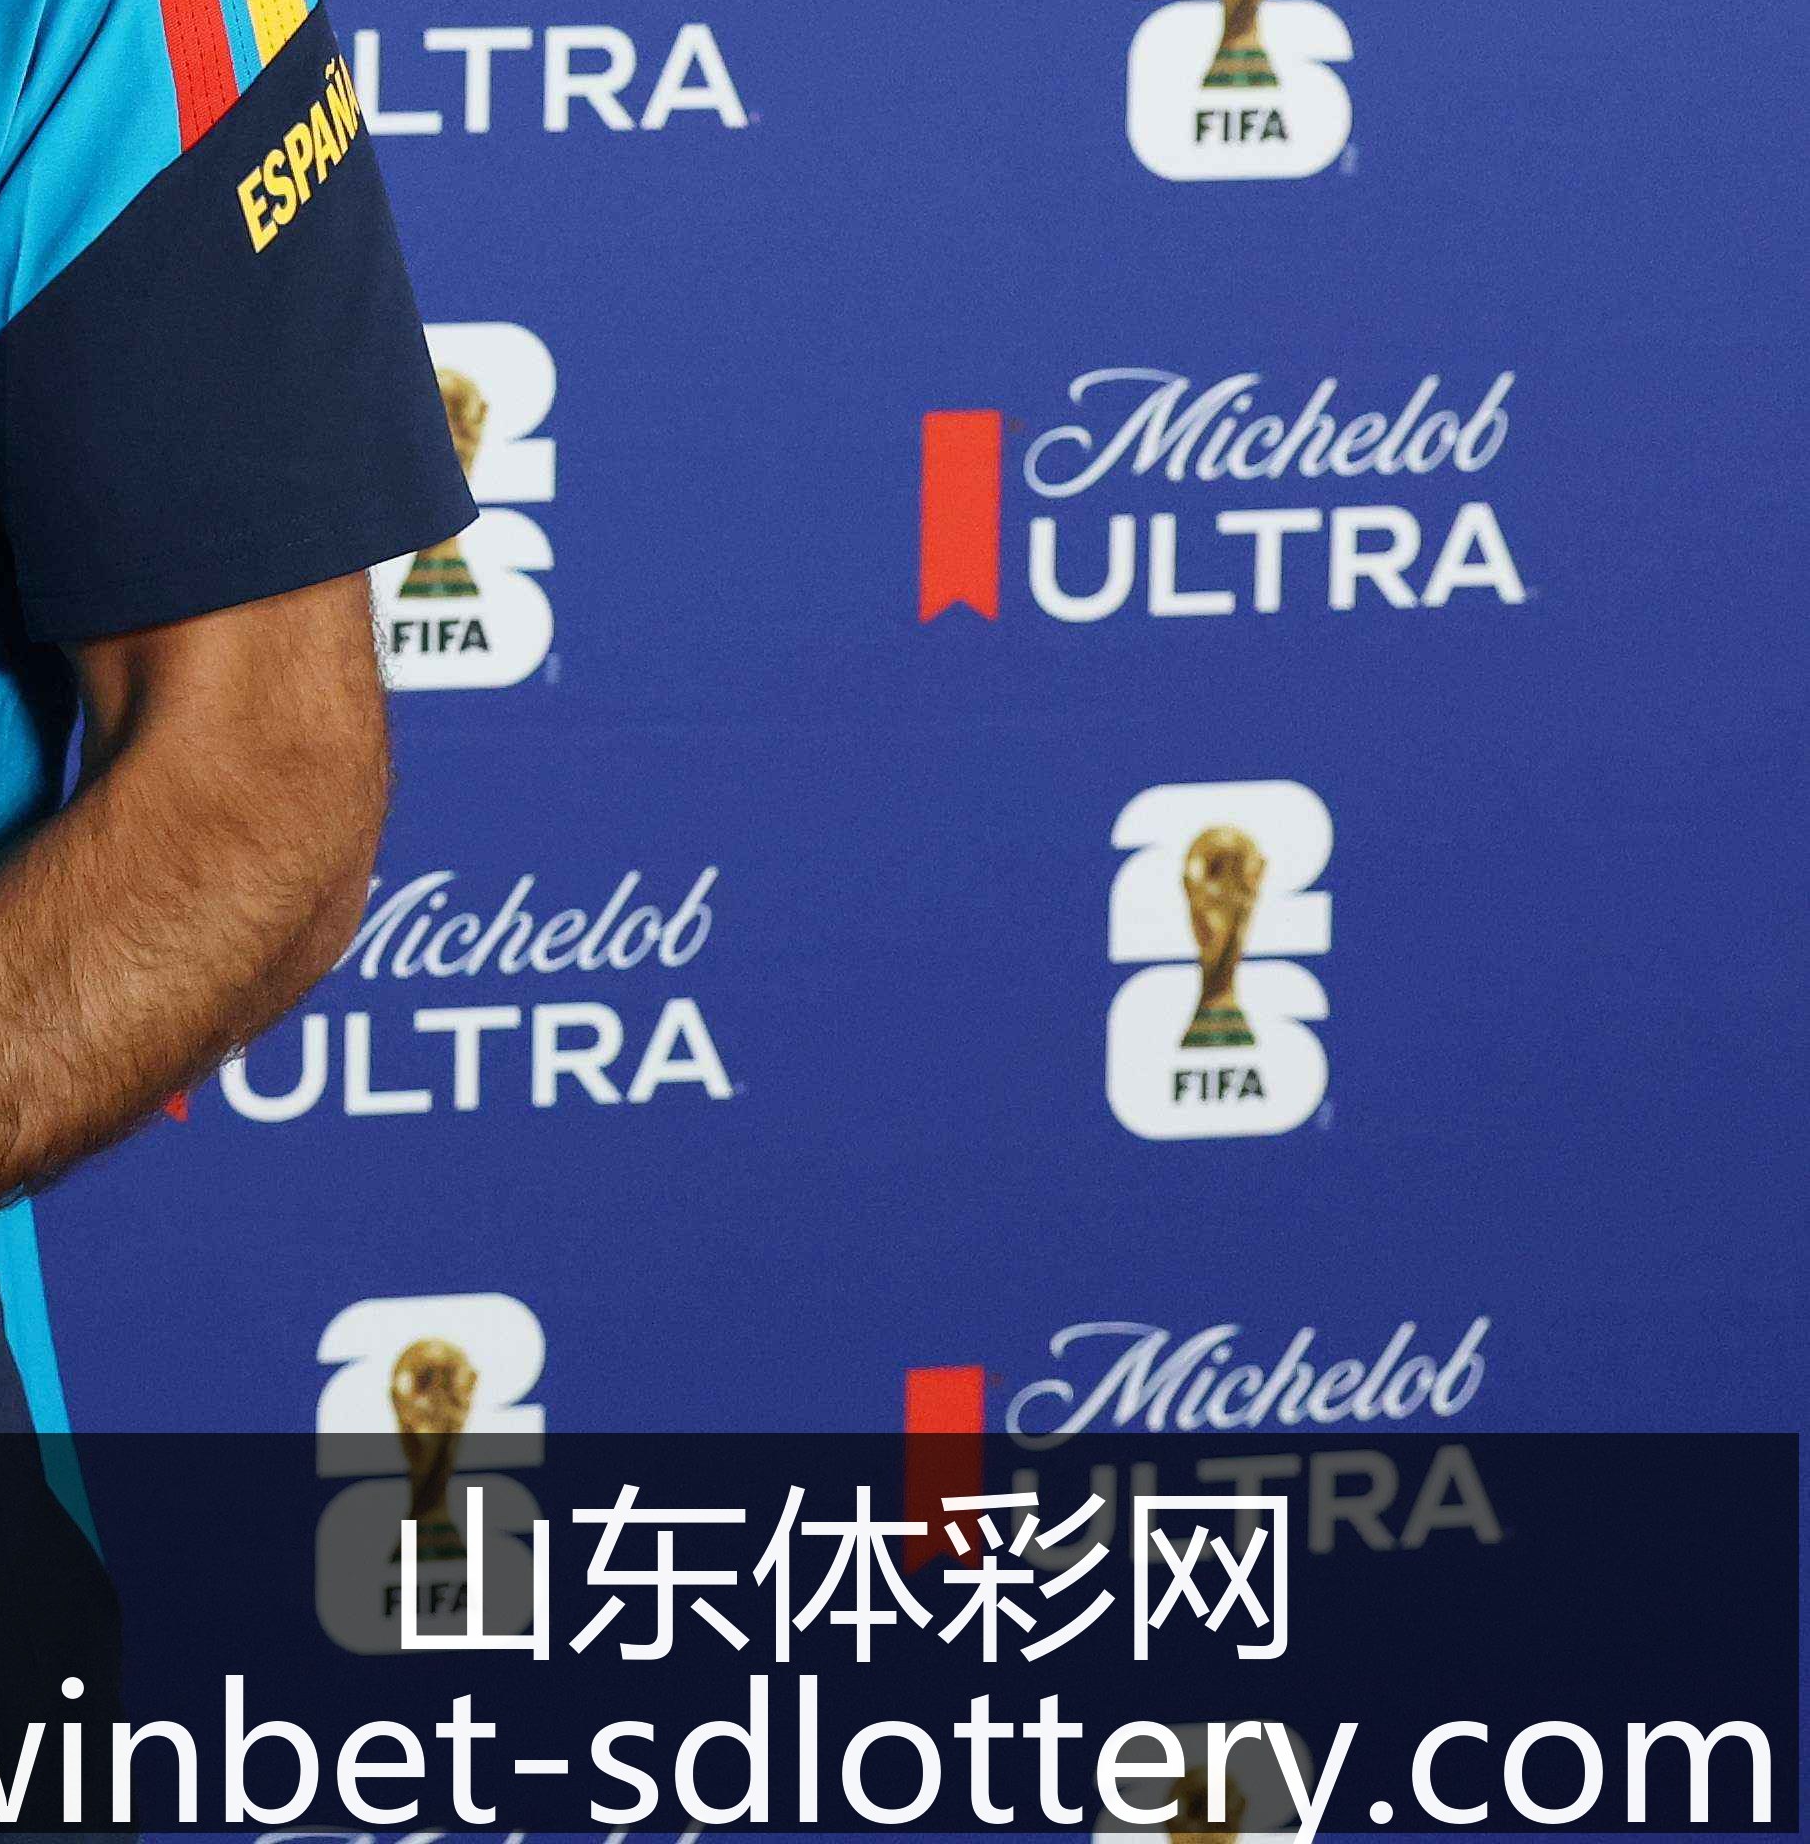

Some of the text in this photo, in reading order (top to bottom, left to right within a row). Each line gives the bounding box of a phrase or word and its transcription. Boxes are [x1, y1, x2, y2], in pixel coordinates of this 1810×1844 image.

[354, 23, 748, 135] LTRA
[1195, 109, 1288, 143] FIFA
[1025, 368, 1514, 498] Michelob
[1029, 502, 1526, 622] ULTRA
[392, 618, 490, 654] FIFA
[219, 997, 733, 1123] ULTRA
[1173, 1067, 1266, 1103] FIFA
[1005, 1316, 1492, 1452] Michelob
